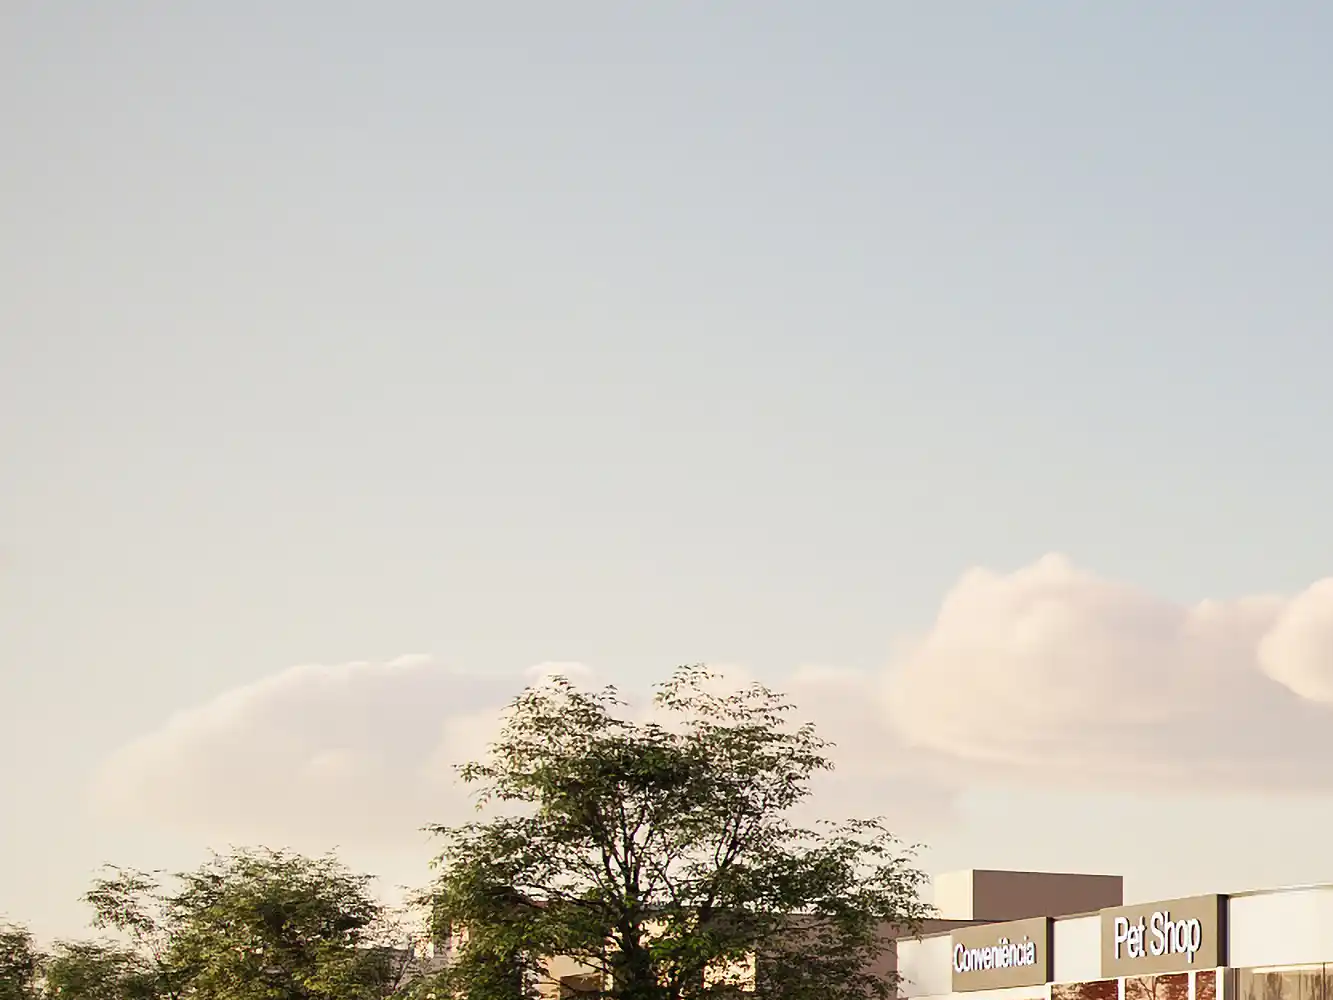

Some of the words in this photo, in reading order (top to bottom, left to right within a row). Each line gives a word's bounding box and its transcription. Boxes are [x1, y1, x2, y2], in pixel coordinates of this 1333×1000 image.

[953, 936, 1036, 973] Conveniência
[1114, 915, 1147, 960] Pet
[1150, 911, 1201, 963] Shop
